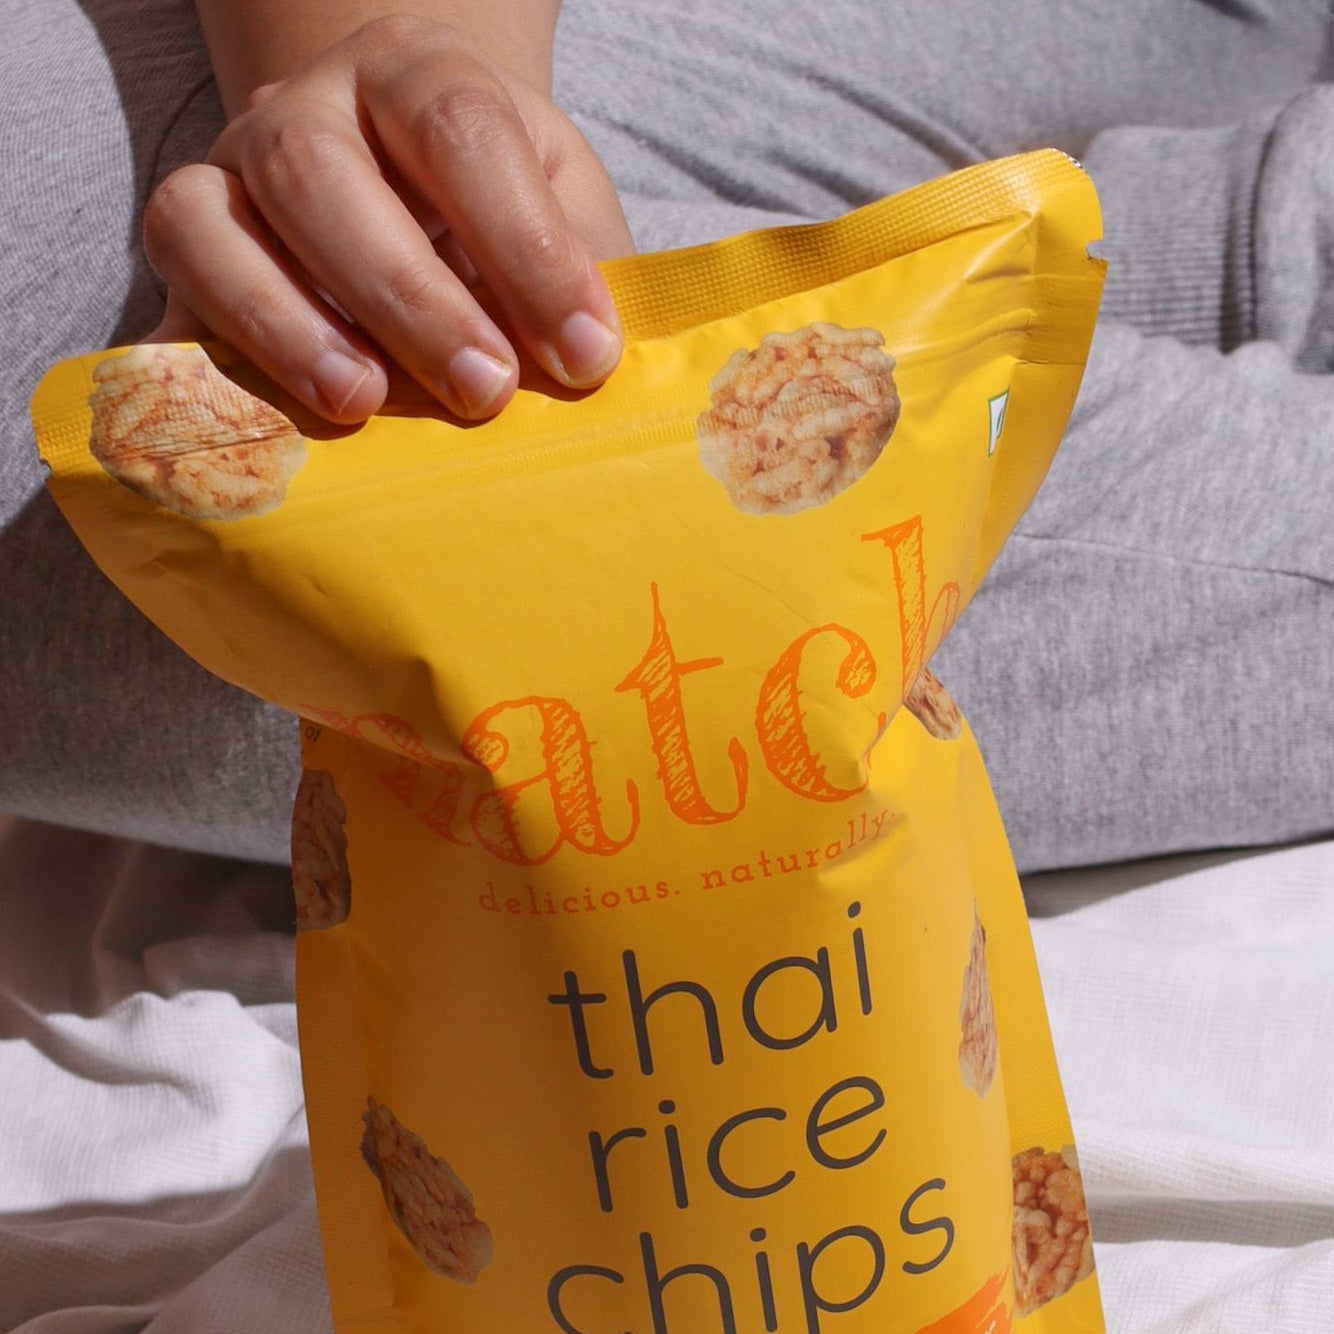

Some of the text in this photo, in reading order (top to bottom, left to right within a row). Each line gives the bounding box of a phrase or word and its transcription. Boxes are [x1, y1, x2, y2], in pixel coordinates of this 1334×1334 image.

[478, 808, 896, 916] delicious. naturally.
[546, 900, 873, 1080] thai
[588, 1075, 888, 1214] rice
